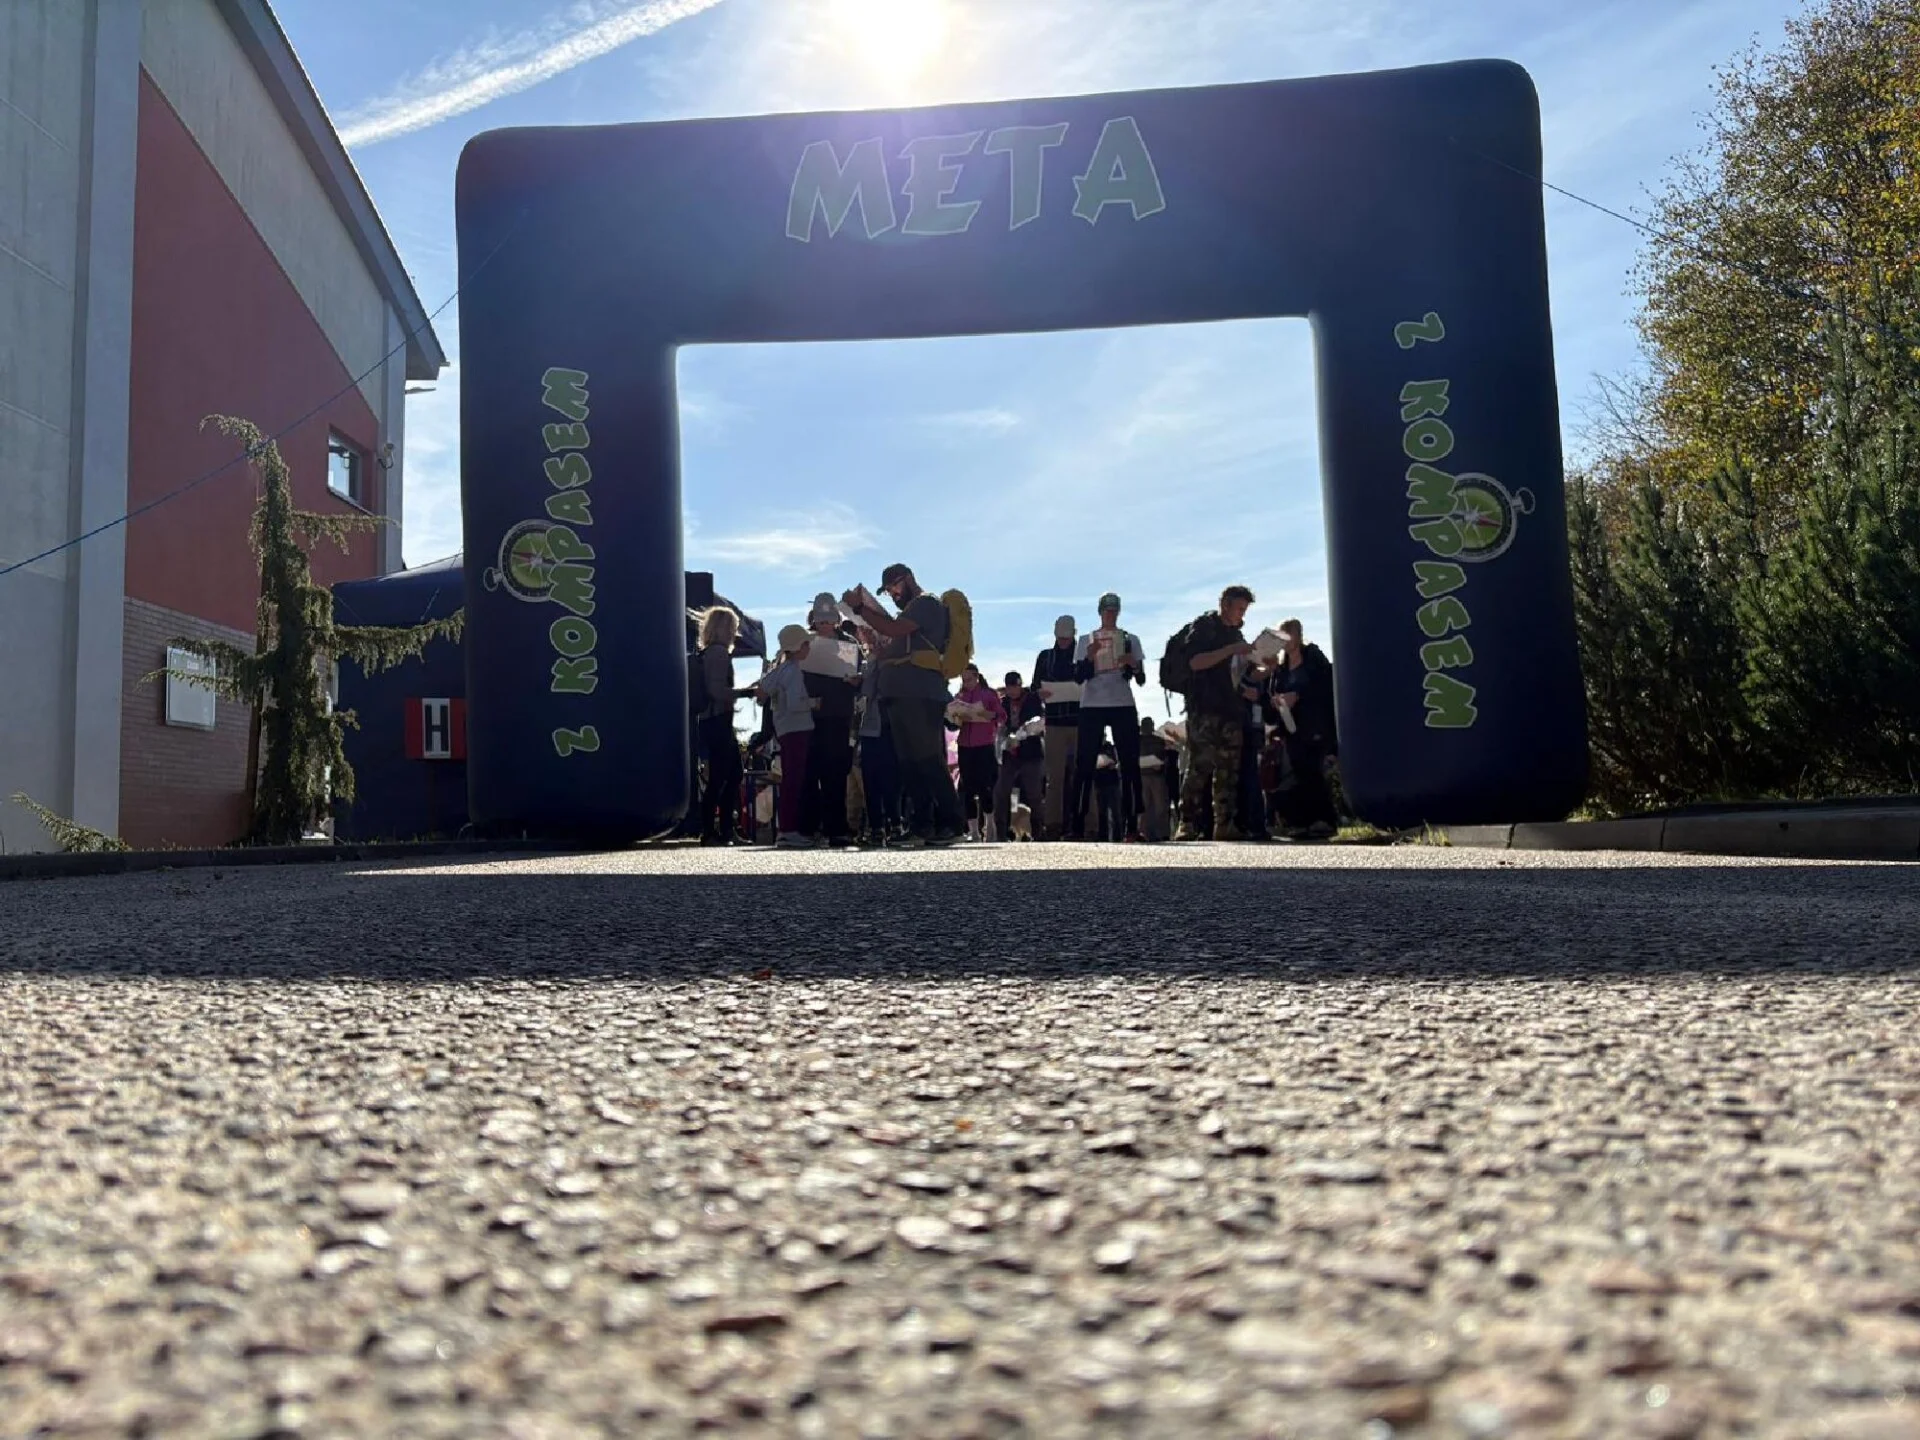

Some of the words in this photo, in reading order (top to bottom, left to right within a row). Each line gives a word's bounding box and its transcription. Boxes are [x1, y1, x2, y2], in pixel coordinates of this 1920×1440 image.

[785, 115, 1166, 243] META
[541, 367, 599, 694] KOMPASEM
[1399, 379, 1478, 728] KOMPASEM
[423, 703, 449, 752] H
